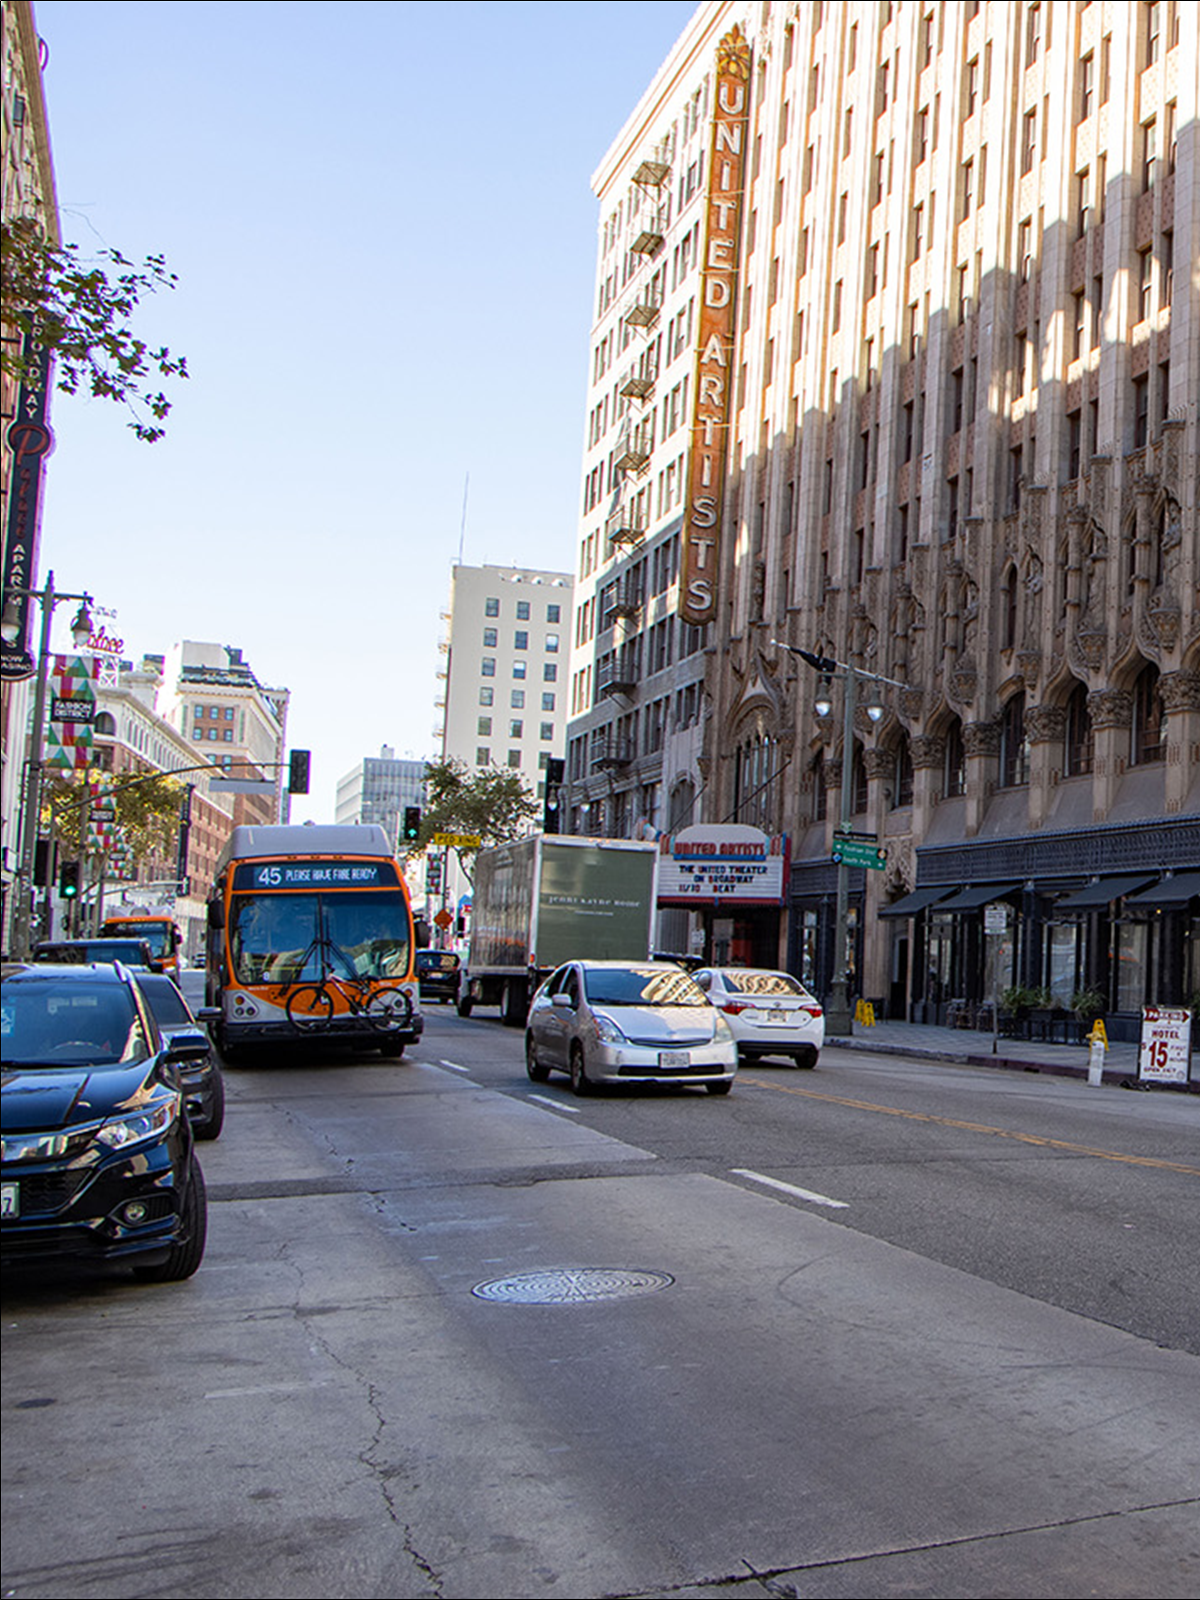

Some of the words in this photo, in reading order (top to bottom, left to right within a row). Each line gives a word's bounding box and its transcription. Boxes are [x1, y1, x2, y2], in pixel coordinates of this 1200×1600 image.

[704, 81, 745, 310] UNITED
[685, 332, 727, 611] ARTISTS
[55, 701, 92, 711] FASHION
[54, 709, 90, 719] DISTRICT
[675, 843, 717, 855] UNITED
[719, 843, 765, 855] ARTISTS
[679, 865, 695, 873] THE
[698, 866, 726, 874] UNITED
[729, 866, 768, 874] THEATER
[258, 868, 282, 885] 45
[286, 869, 311, 882] PLEASE
[694, 875, 705, 883] ON
[708, 875, 755, 883] BROADWAY
[713, 885, 736, 893] BEAT
[1152, 1030, 1180, 1039] HOTEL
